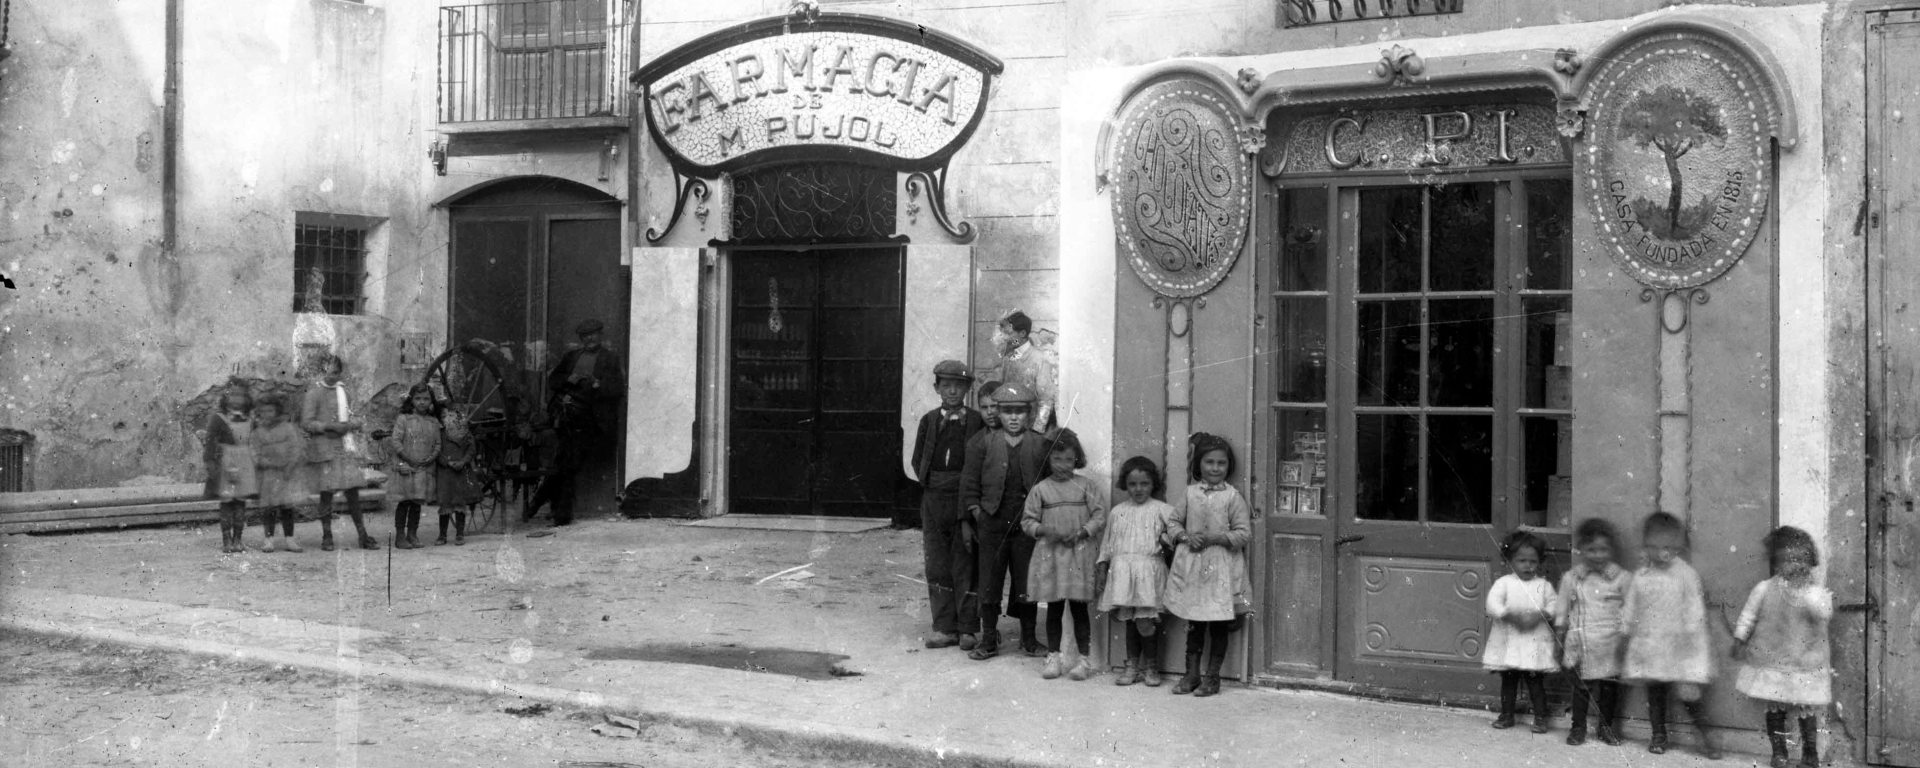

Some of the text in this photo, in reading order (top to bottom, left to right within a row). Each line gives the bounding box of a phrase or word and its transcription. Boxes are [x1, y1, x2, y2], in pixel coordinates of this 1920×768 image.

[650, 45, 959, 134] FARMACIA
[766, 114, 897, 148] PUJOL
[1610, 171, 1743, 263] CASA FUNDADA EN 1815
